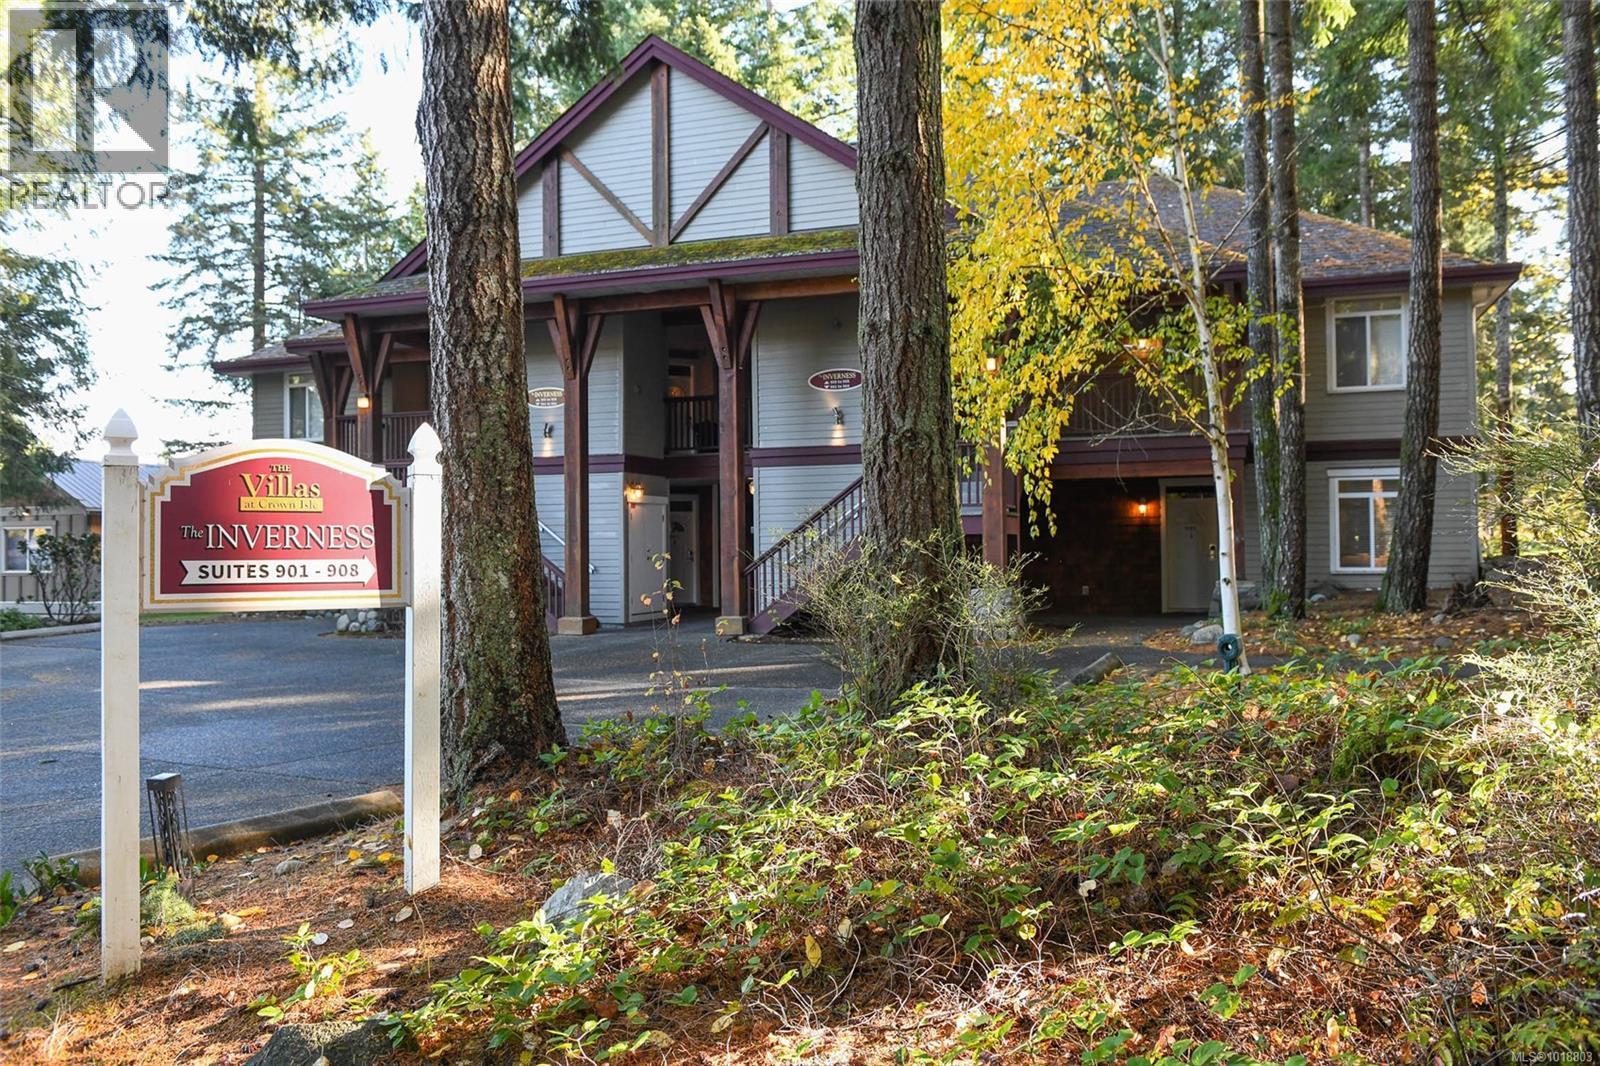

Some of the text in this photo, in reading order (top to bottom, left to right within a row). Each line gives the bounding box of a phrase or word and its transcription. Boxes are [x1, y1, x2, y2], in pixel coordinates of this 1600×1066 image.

[269, 464, 291, 473] THE
[240, 473, 321, 498] Villas
[244, 499, 319, 510] at Crown Isle
[181, 523, 375, 550] The INVERNESS
[198, 564, 269, 579] SUITES
[275, 563, 308, 578] 901
[327, 563, 359, 578] 908
